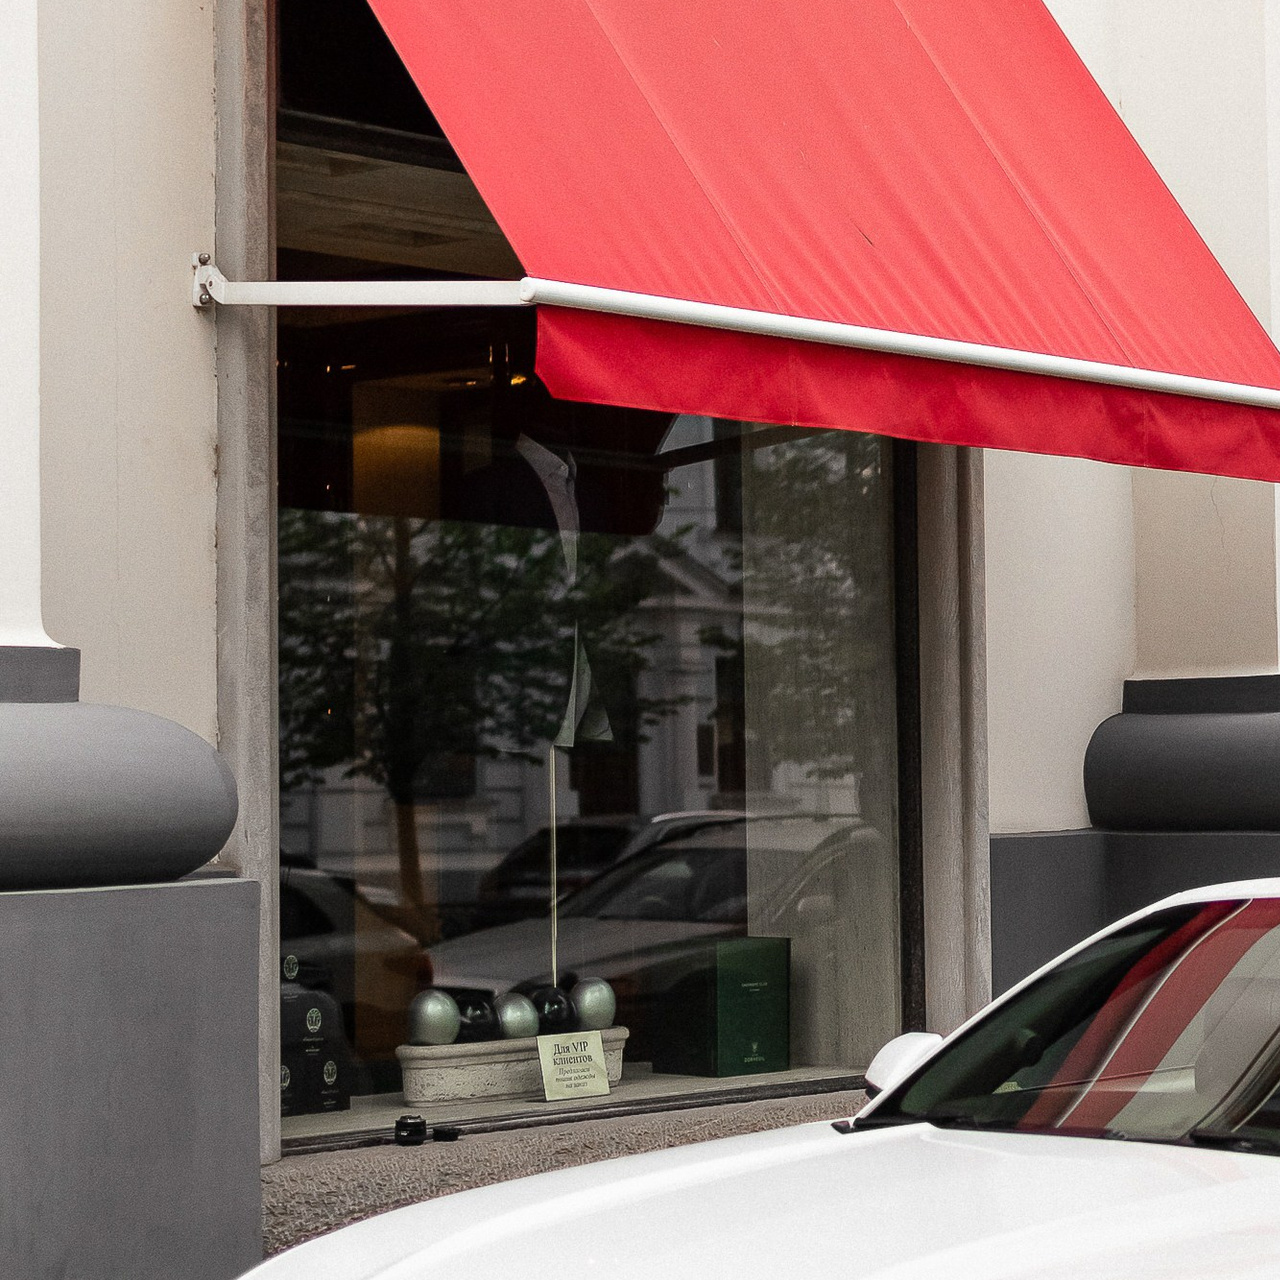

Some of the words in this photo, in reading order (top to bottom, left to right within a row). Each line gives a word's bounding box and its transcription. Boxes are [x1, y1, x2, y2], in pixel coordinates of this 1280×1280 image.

[553, 1043, 571, 1056] Для
[572, 1041, 588, 1053] VIP
[552, 1054, 593, 1066] клиентов
